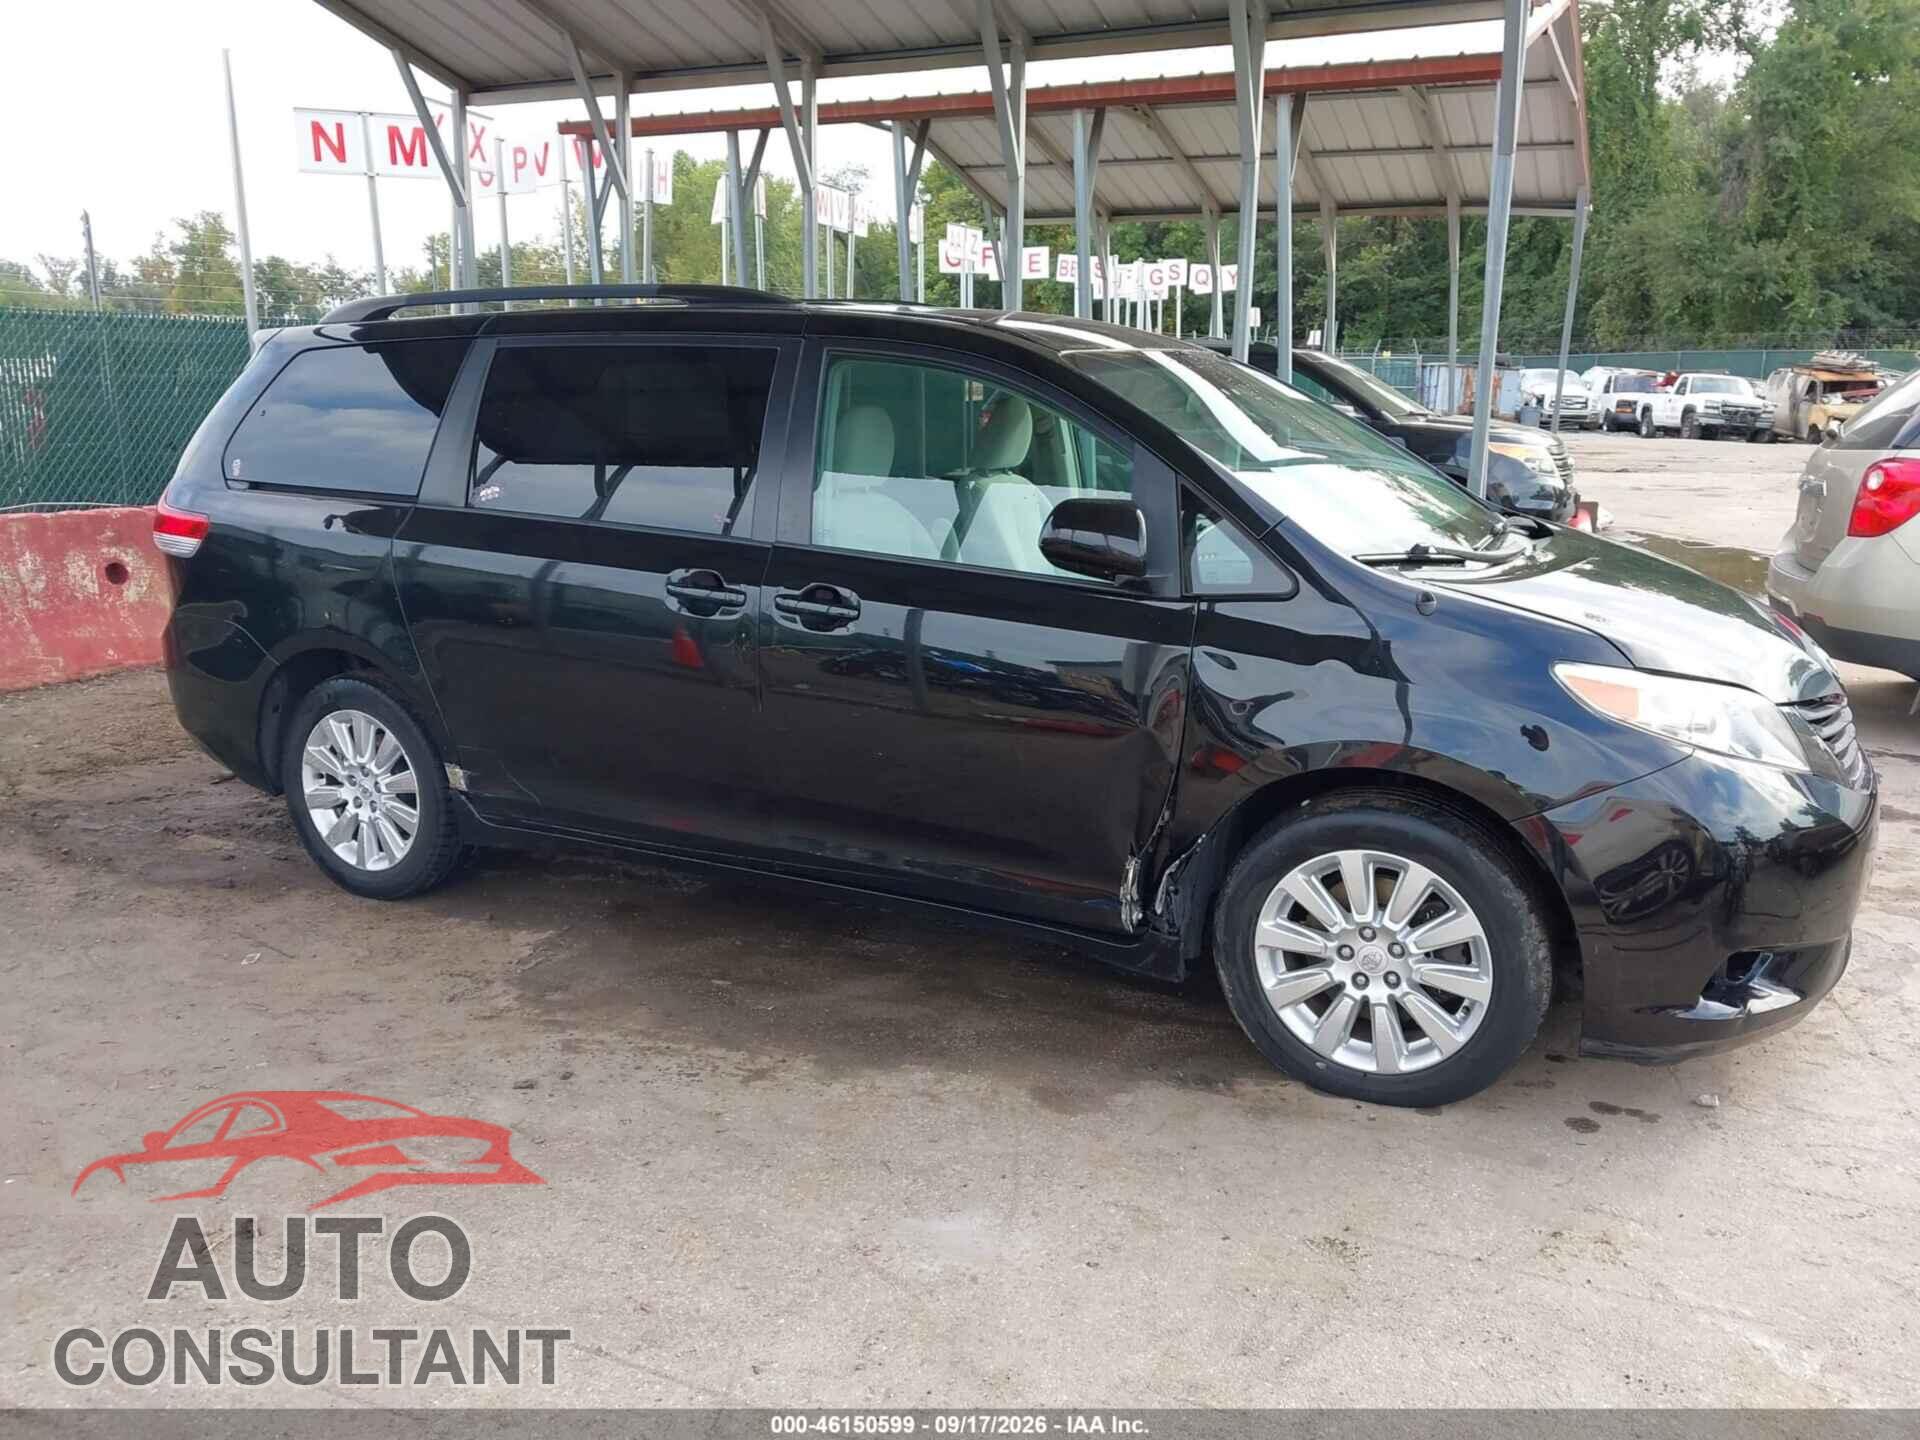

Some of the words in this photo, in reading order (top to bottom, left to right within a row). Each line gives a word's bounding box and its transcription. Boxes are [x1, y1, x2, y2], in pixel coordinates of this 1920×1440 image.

[311, 121, 347, 163] N
[387, 125, 429, 167] M
[469, 121, 487, 163] X
[534, 142, 550, 176] V
[512, 146, 527, 183] P
[656, 160, 668, 195] H
[982, 247, 993, 268] F
[1028, 252, 1042, 273] E
[1169, 264, 1181, 280] S
[1150, 268, 1164, 285] G
[1195, 269, 1209, 286] Q
